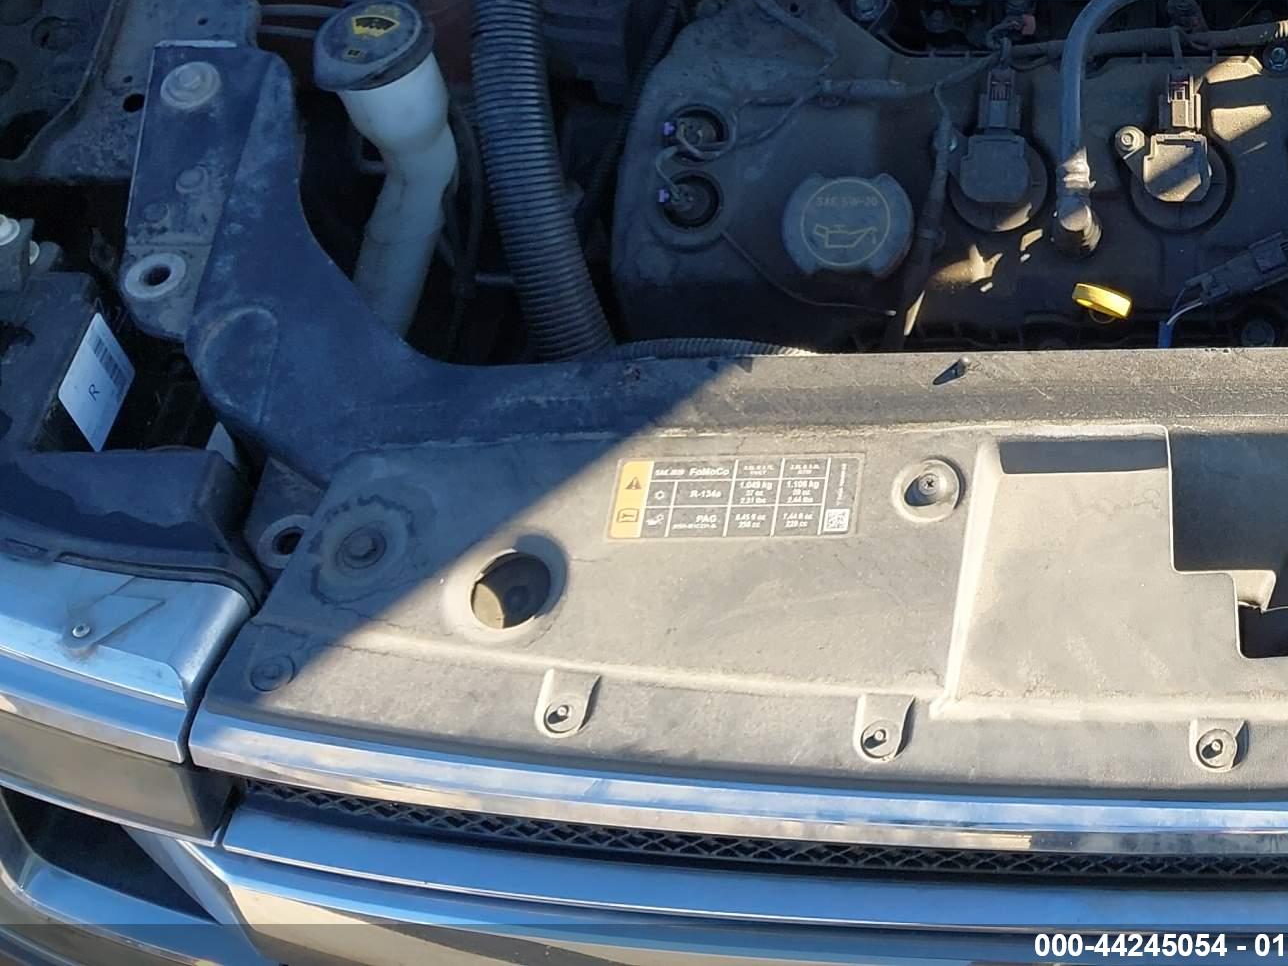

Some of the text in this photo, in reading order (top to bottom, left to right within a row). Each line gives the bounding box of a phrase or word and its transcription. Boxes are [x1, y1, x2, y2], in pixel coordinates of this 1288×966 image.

[815, 194, 879, 208] SAE 5W-20
[88, 383, 101, 402] R
[688, 466, 730, 476] FoMoCo
[689, 489, 722, 498] R-134a
[695, 514, 718, 523] PAG
